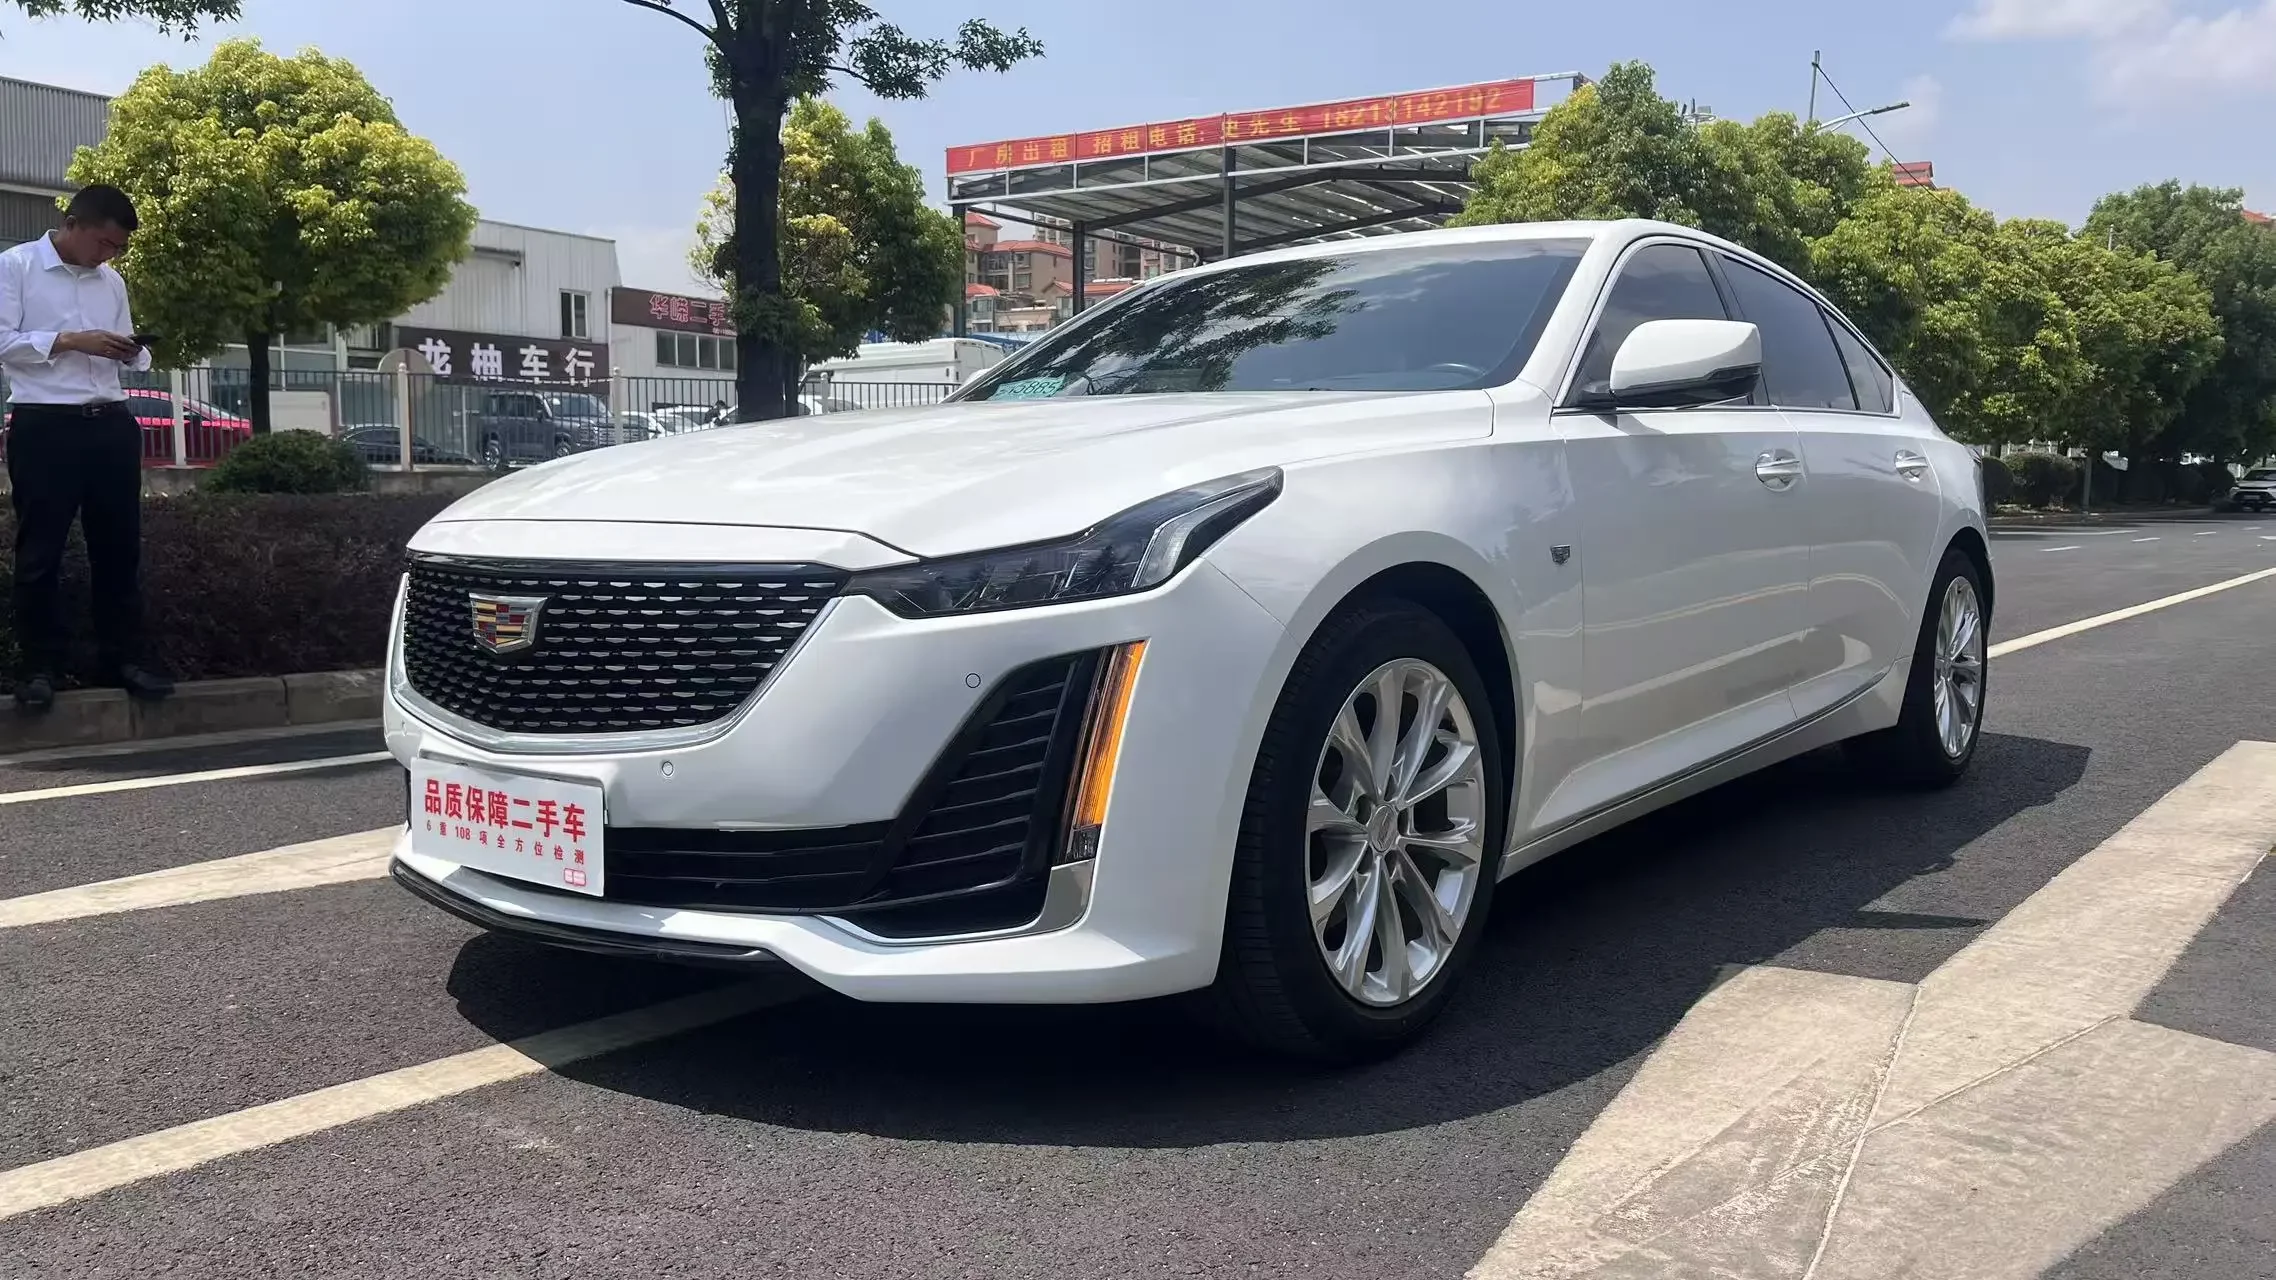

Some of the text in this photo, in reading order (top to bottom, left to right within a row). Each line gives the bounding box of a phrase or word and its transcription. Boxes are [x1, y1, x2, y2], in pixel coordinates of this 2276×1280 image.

[967, 136, 1069, 168] 厂房出租
[418, 337, 596, 387] 龙柚车行
[424, 778, 586, 843] 品质保障二手车
